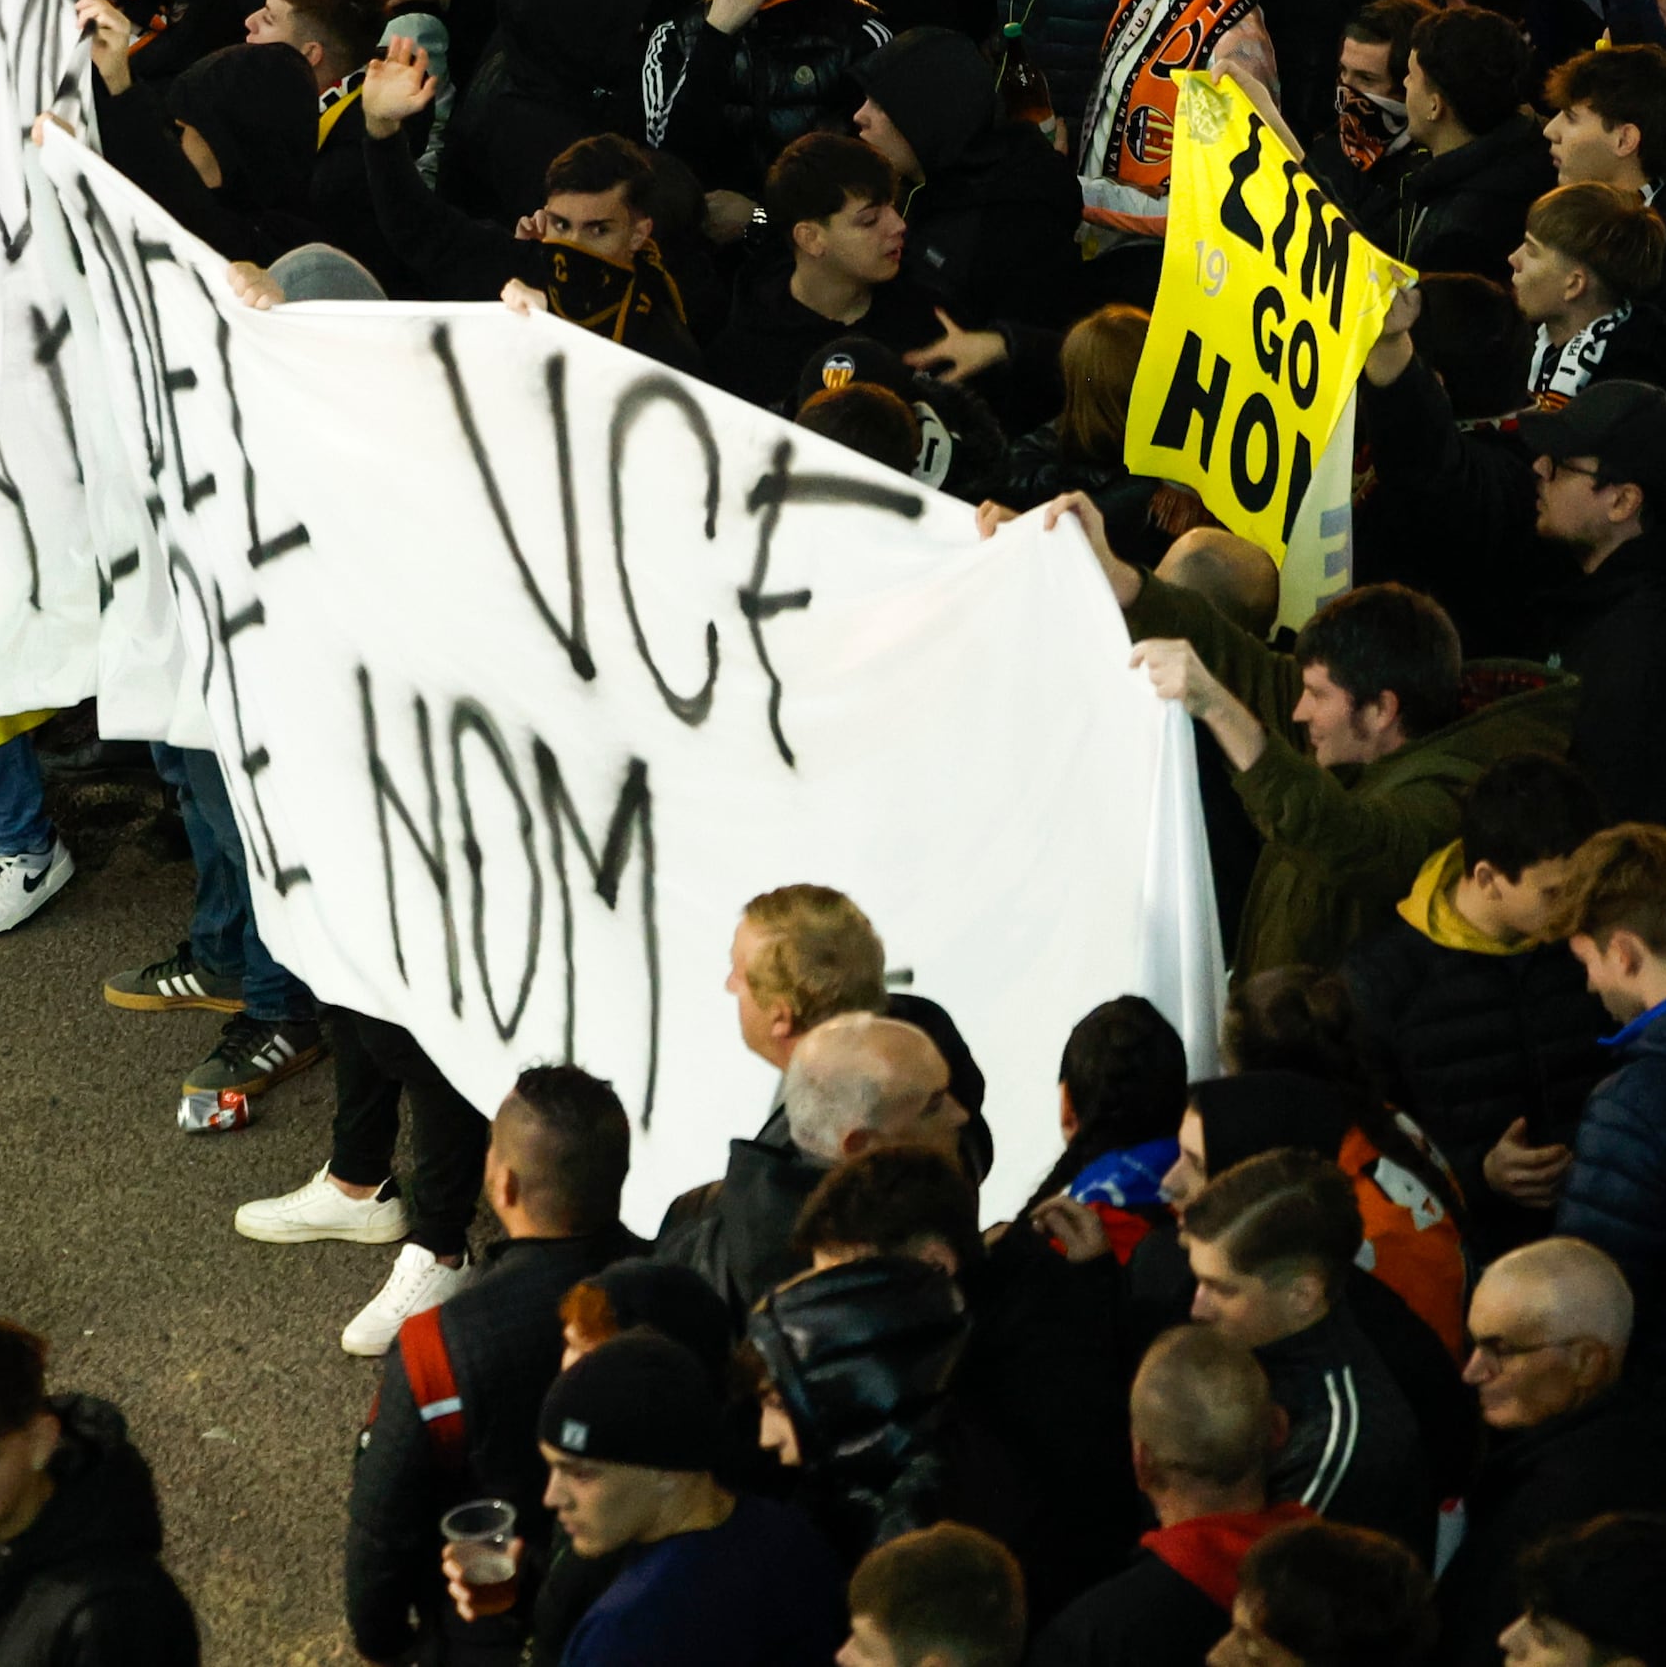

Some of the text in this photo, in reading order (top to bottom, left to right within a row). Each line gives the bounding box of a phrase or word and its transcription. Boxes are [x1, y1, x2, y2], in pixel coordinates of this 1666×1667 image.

[1220, 111, 1350, 334] LIM
[1251, 284, 1320, 411] GO
[430, 322, 924, 773] VCF
